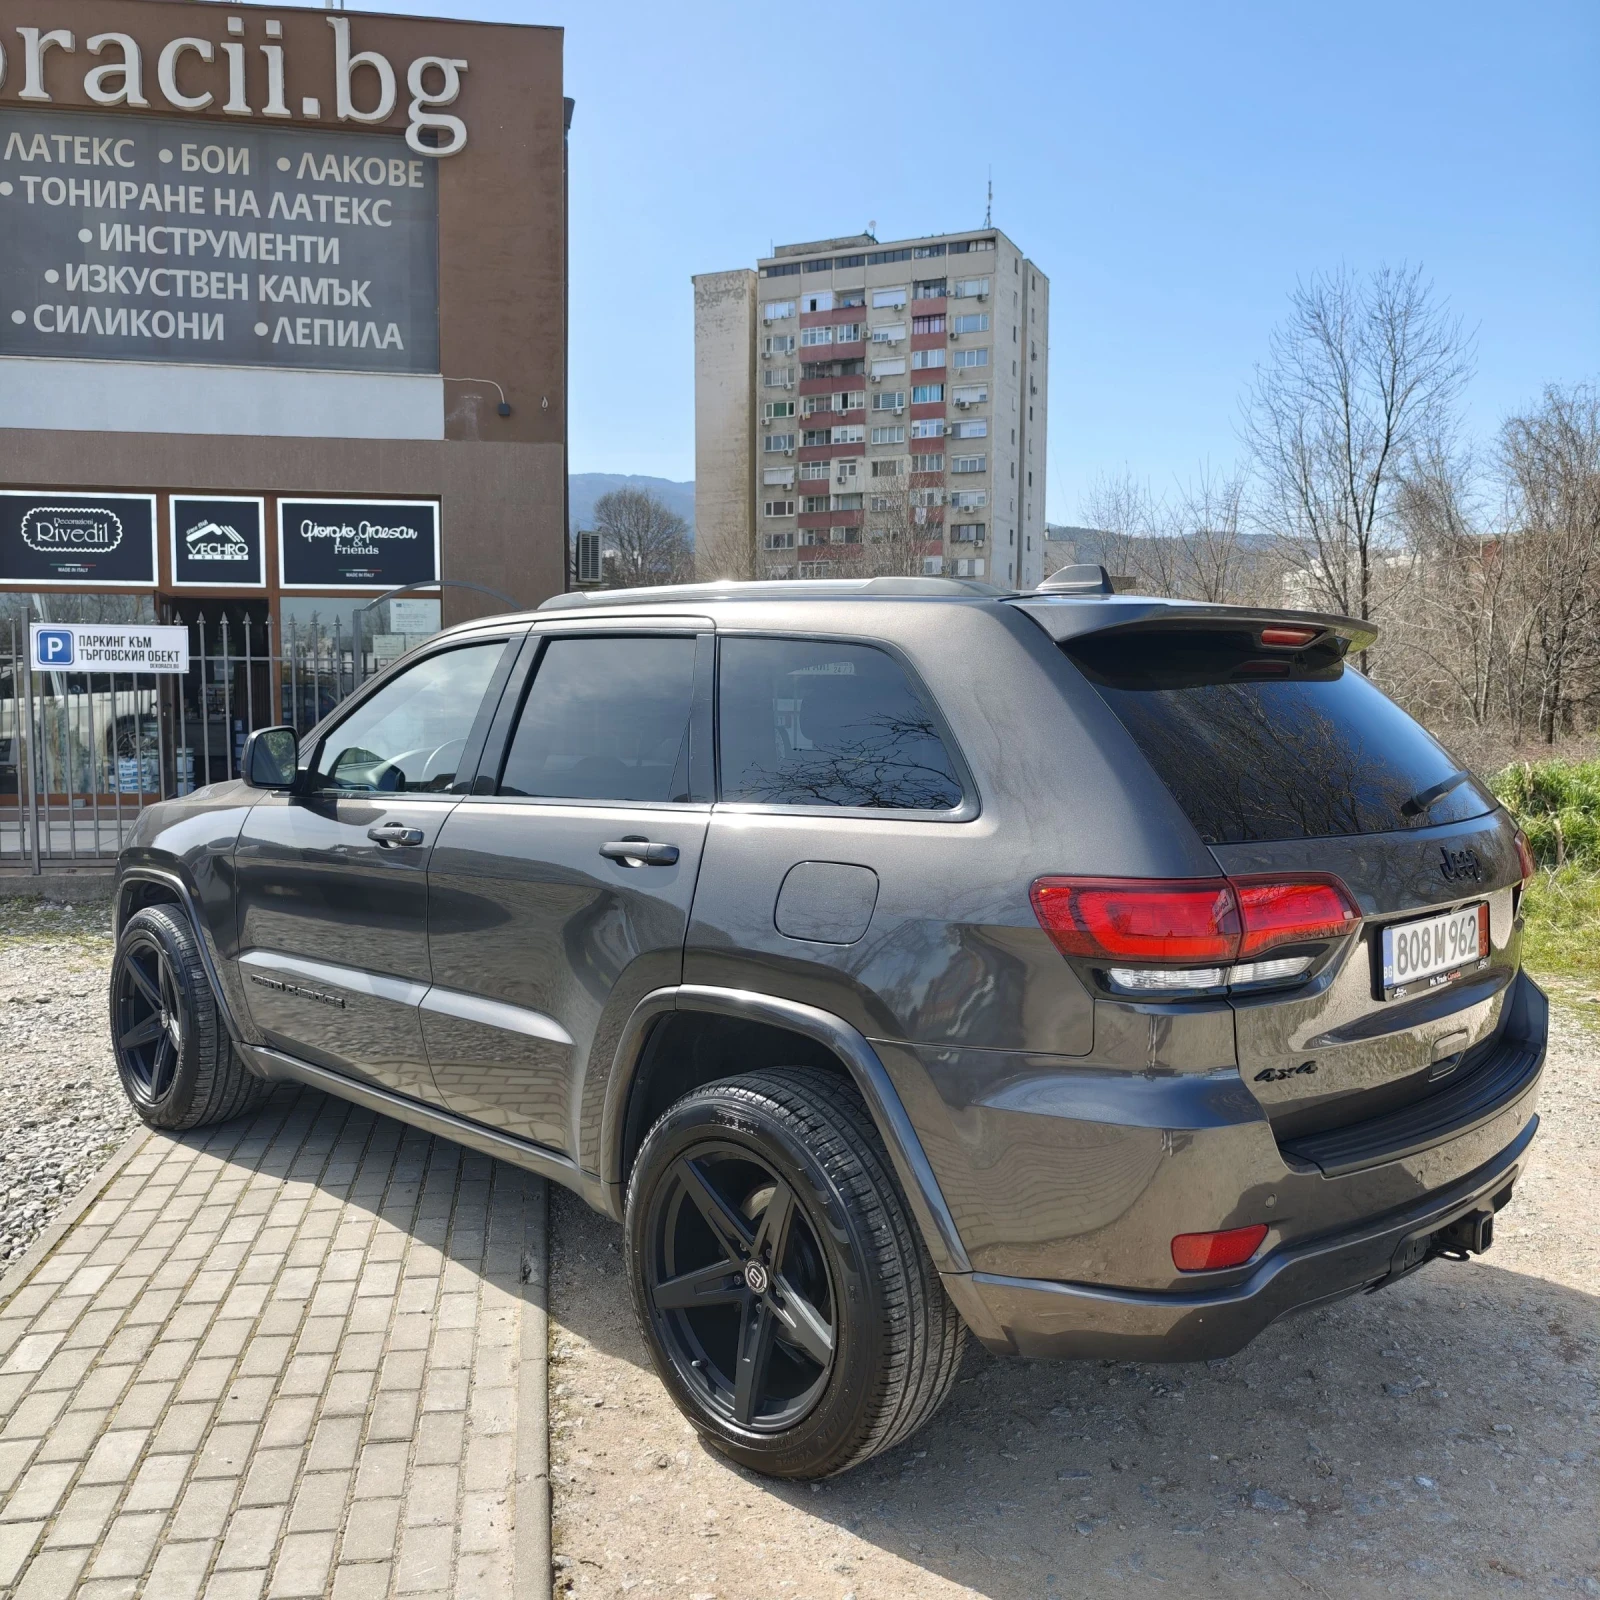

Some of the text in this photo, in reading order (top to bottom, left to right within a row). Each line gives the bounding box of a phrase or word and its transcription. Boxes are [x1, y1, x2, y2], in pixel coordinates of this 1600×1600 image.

[0, 16, 469, 157] racii.bg
[4, 132, 424, 188] ЛАТЕКС БОИ ЛАКОВЕ
[20, 175, 392, 227] ТОНИРАНЕ НА ЛАТЕКС
[100, 223, 340, 265] ИНСТРУМЕНТИ
[65, 263, 372, 308] ИЗКУСТВЕН КАМЪК
[33, 304, 404, 350] СИЛИКОНИ ЛЕПИЛА
[36, 521, 109, 543] Rivedil
[187, 542, 249, 556] VECHRO
[334, 544, 380, 555] Friends
[78, 635, 152, 648] ПАРКИНГ КЪМ
[79, 648, 180, 663] ТЪРГОВСКИЯ ОБЕКТ
[1439, 845, 1481, 883] Jeep
[1397, 926, 1431, 976] 808
[1449, 915, 1477, 960] 962
[1383, 965, 1393, 979] BG
[1253, 1060, 1318, 1083] 4x4
